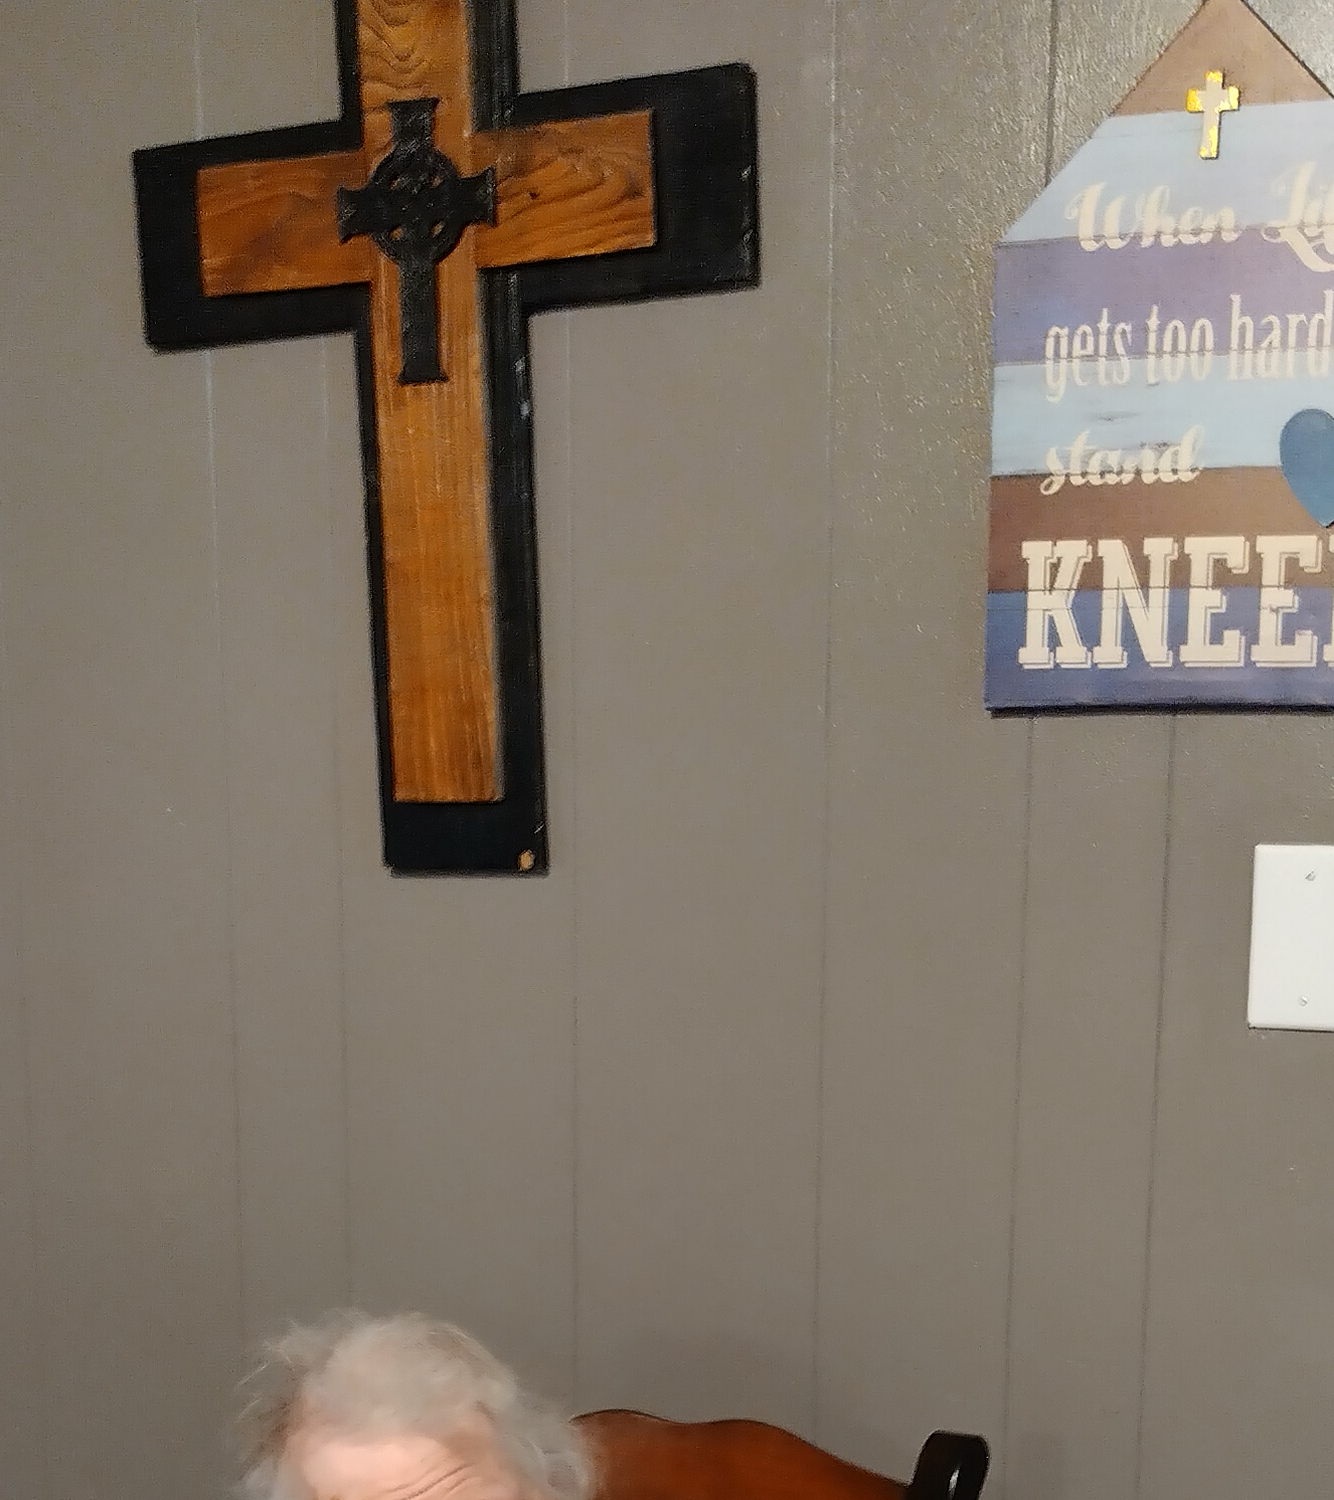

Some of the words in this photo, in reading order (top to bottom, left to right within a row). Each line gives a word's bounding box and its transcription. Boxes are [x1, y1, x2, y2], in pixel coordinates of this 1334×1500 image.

[1065, 180, 1244, 253] When
[1043, 305, 1133, 404] gets
[1145, 301, 1216, 385] too
[1228, 288, 1334, 382] hard
[1039, 424, 1204, 496] stand
